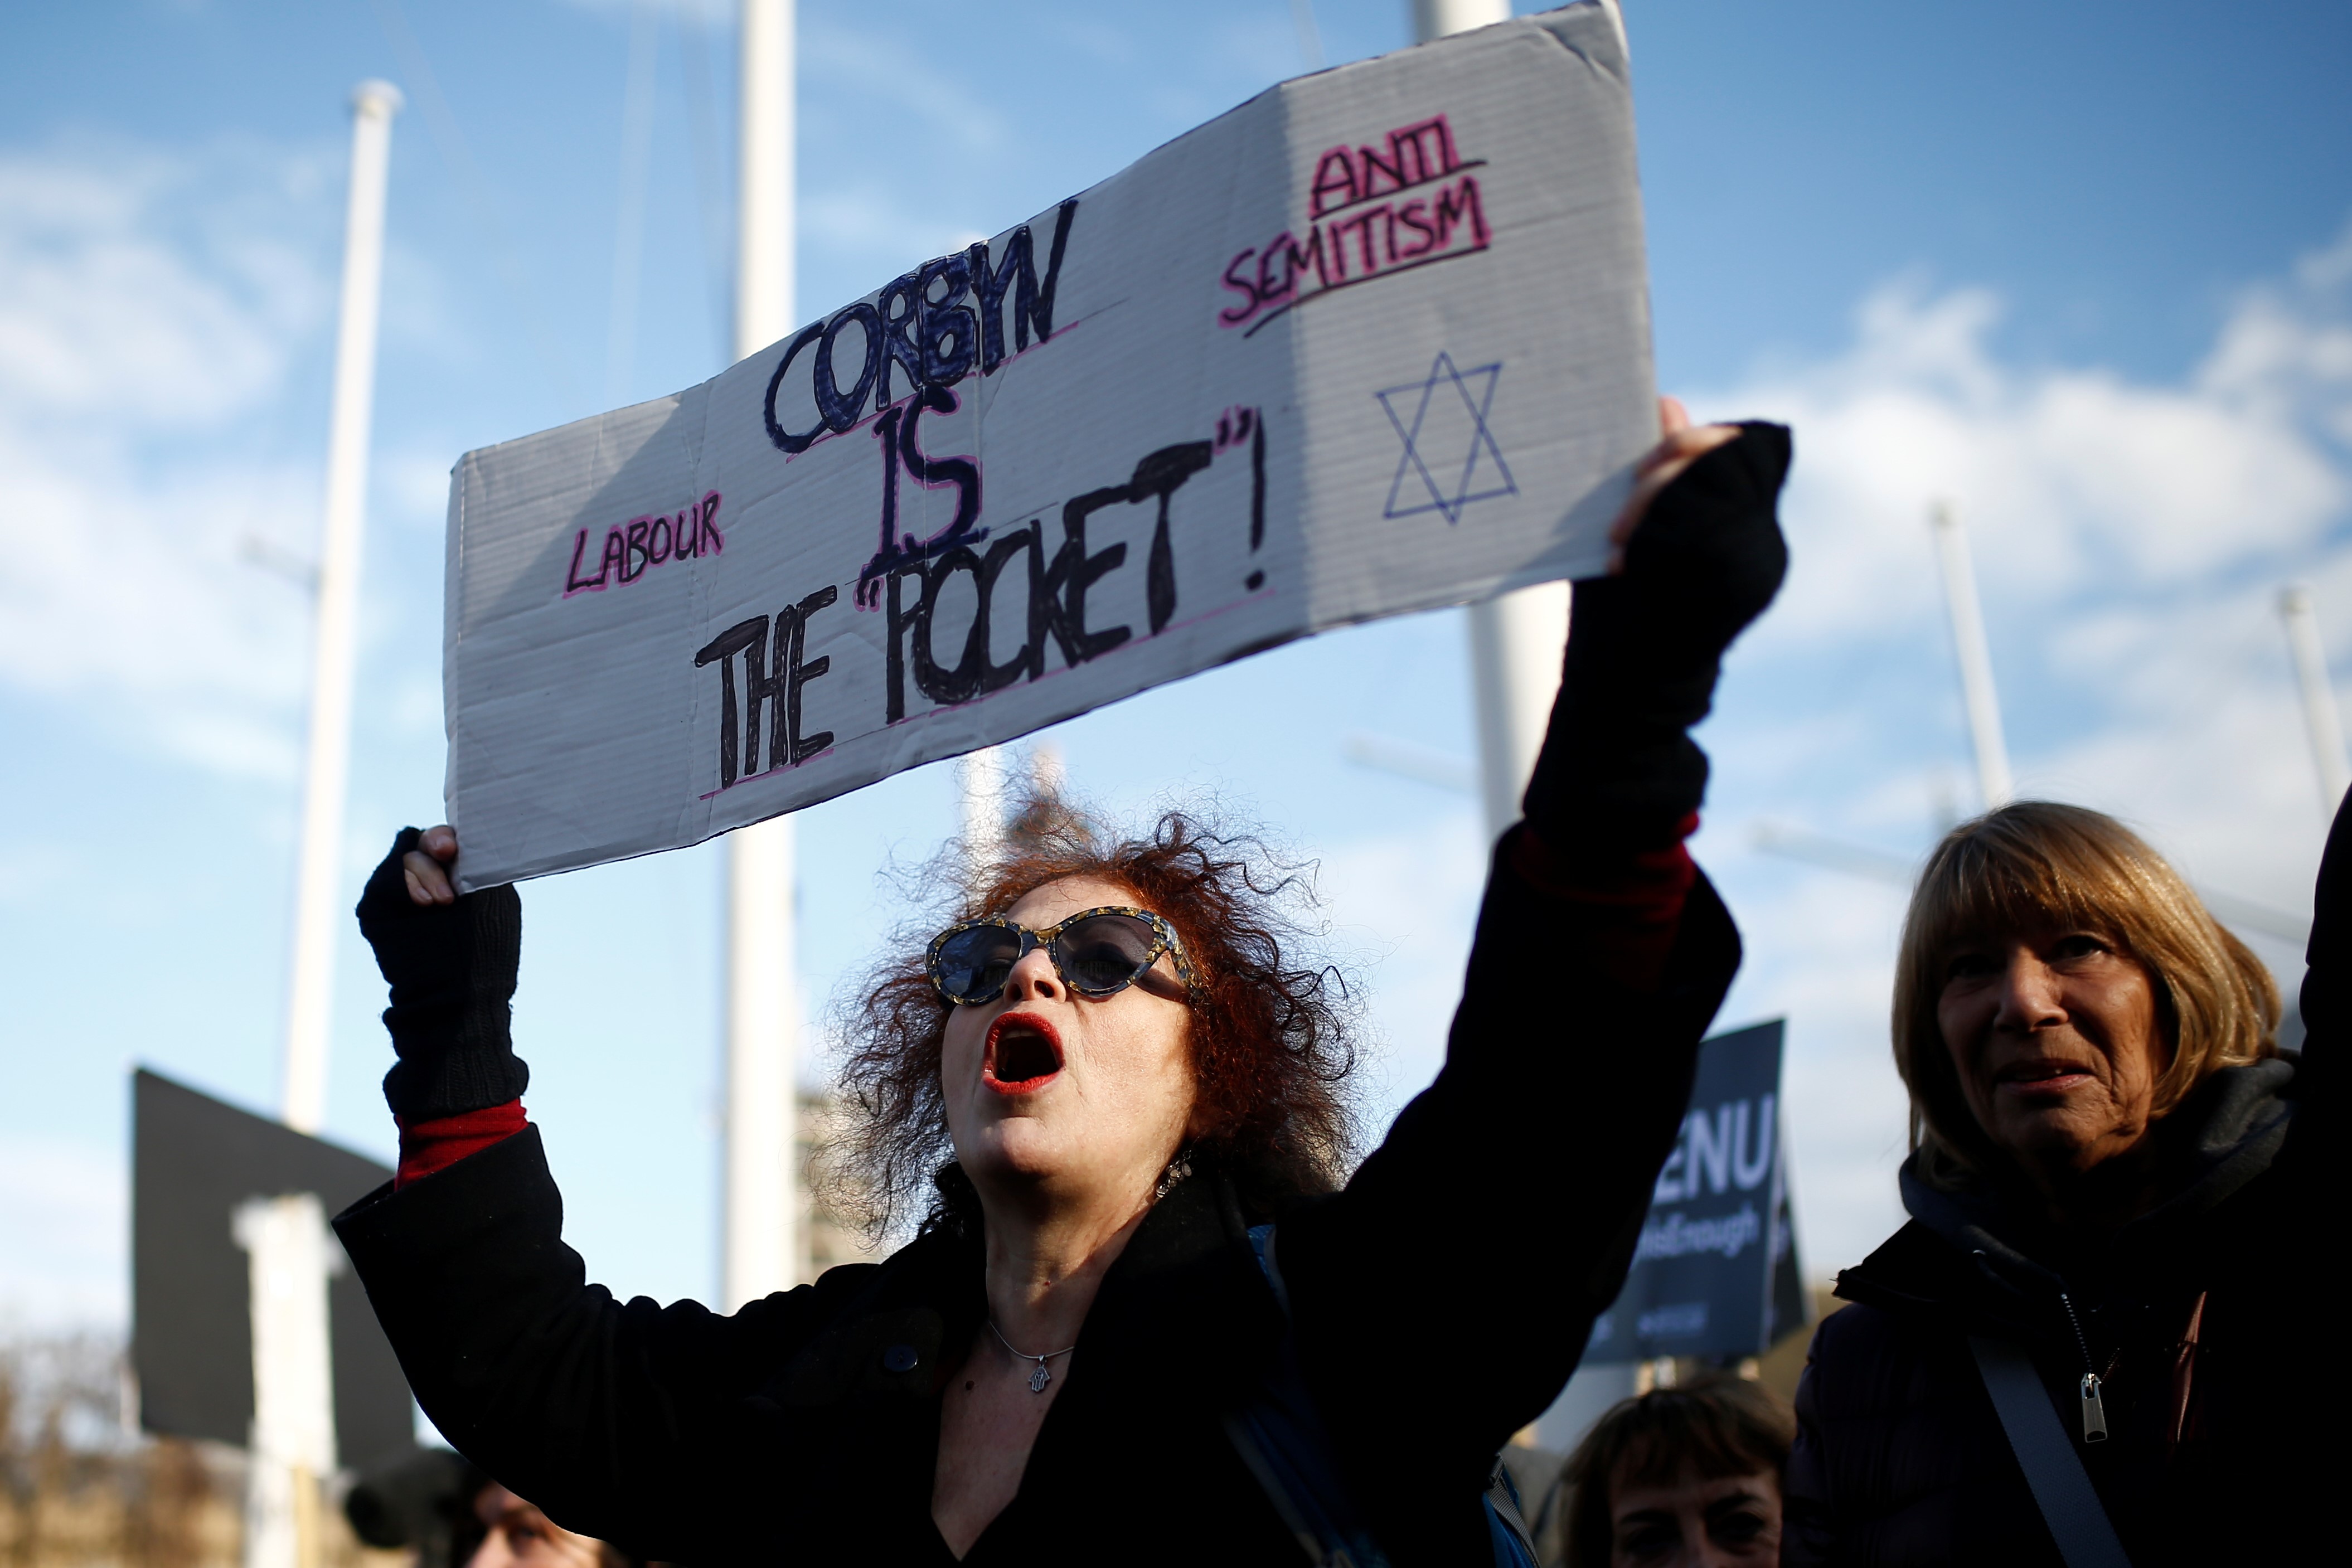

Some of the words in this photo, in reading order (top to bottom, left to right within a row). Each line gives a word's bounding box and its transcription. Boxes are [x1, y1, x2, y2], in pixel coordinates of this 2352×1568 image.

[1218, 176, 1491, 328] SEMITISM
[1308, 113, 1461, 219] ANTI
[763, 199, 1079, 454] CORBYN
[562, 488, 725, 600] LABOUR
[859, 383, 990, 582] IS
[695, 585, 837, 790] THE
